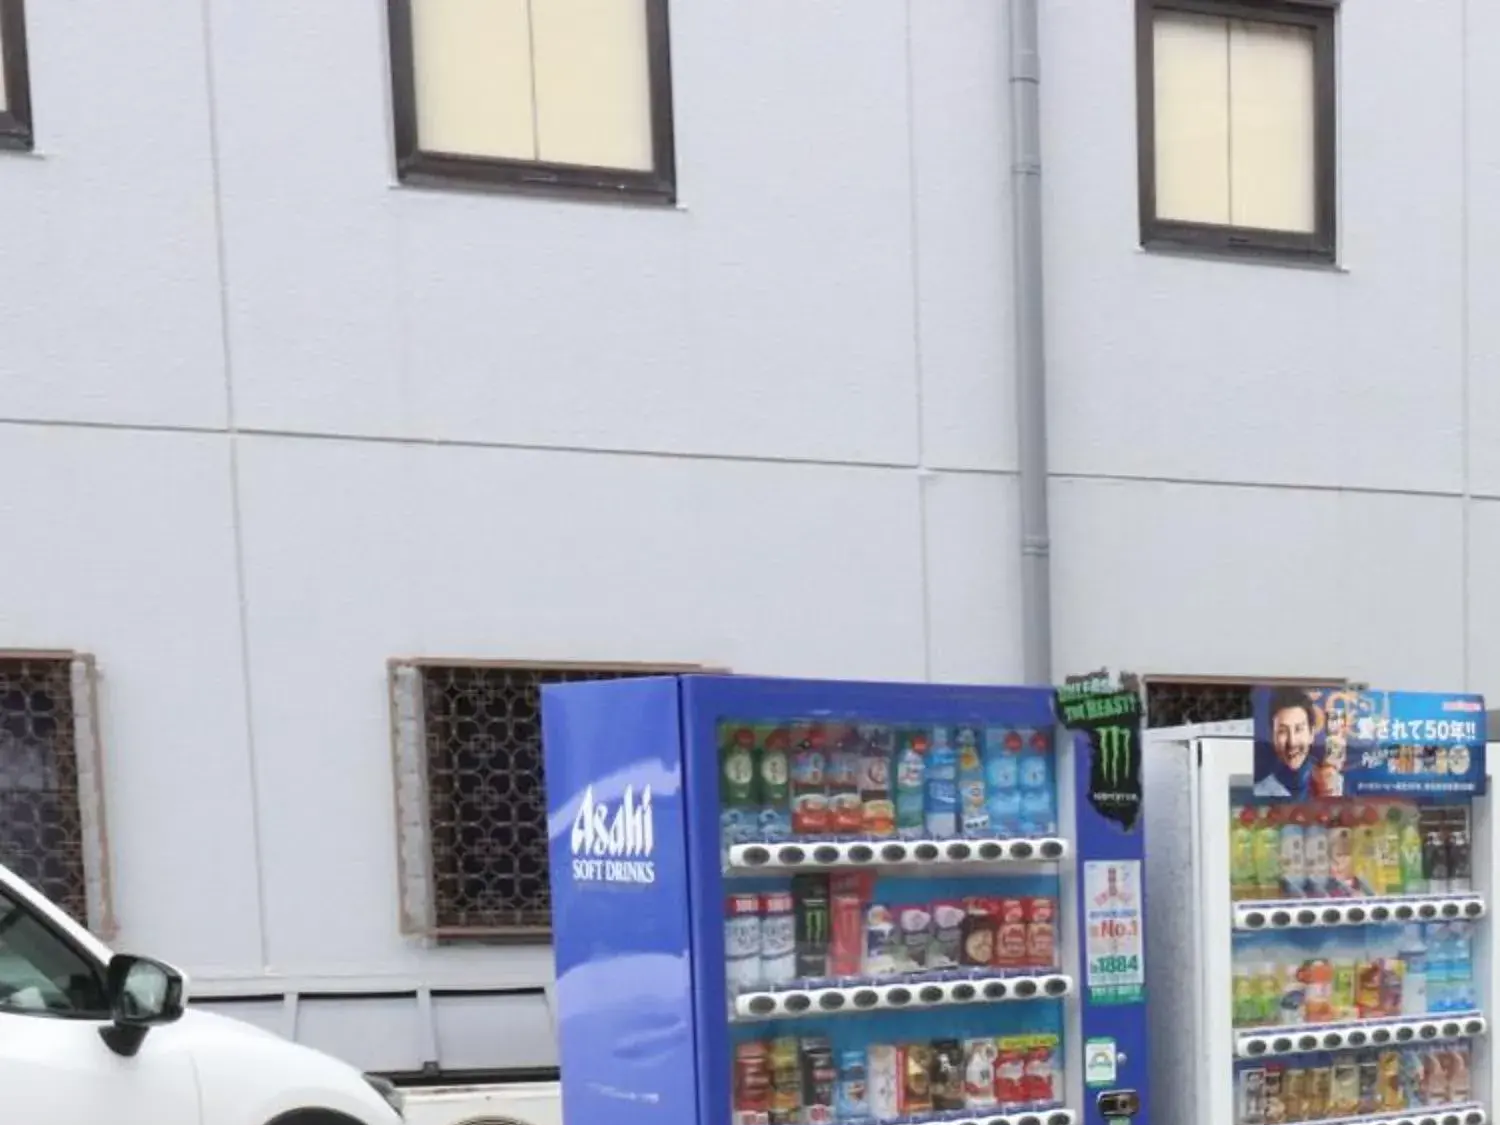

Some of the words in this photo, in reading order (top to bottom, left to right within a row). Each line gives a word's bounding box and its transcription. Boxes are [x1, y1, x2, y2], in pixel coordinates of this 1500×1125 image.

[571, 783, 653, 857] Asahi
[572, 859, 602, 880] SOFT
[605, 860, 655, 883] DRINKS
